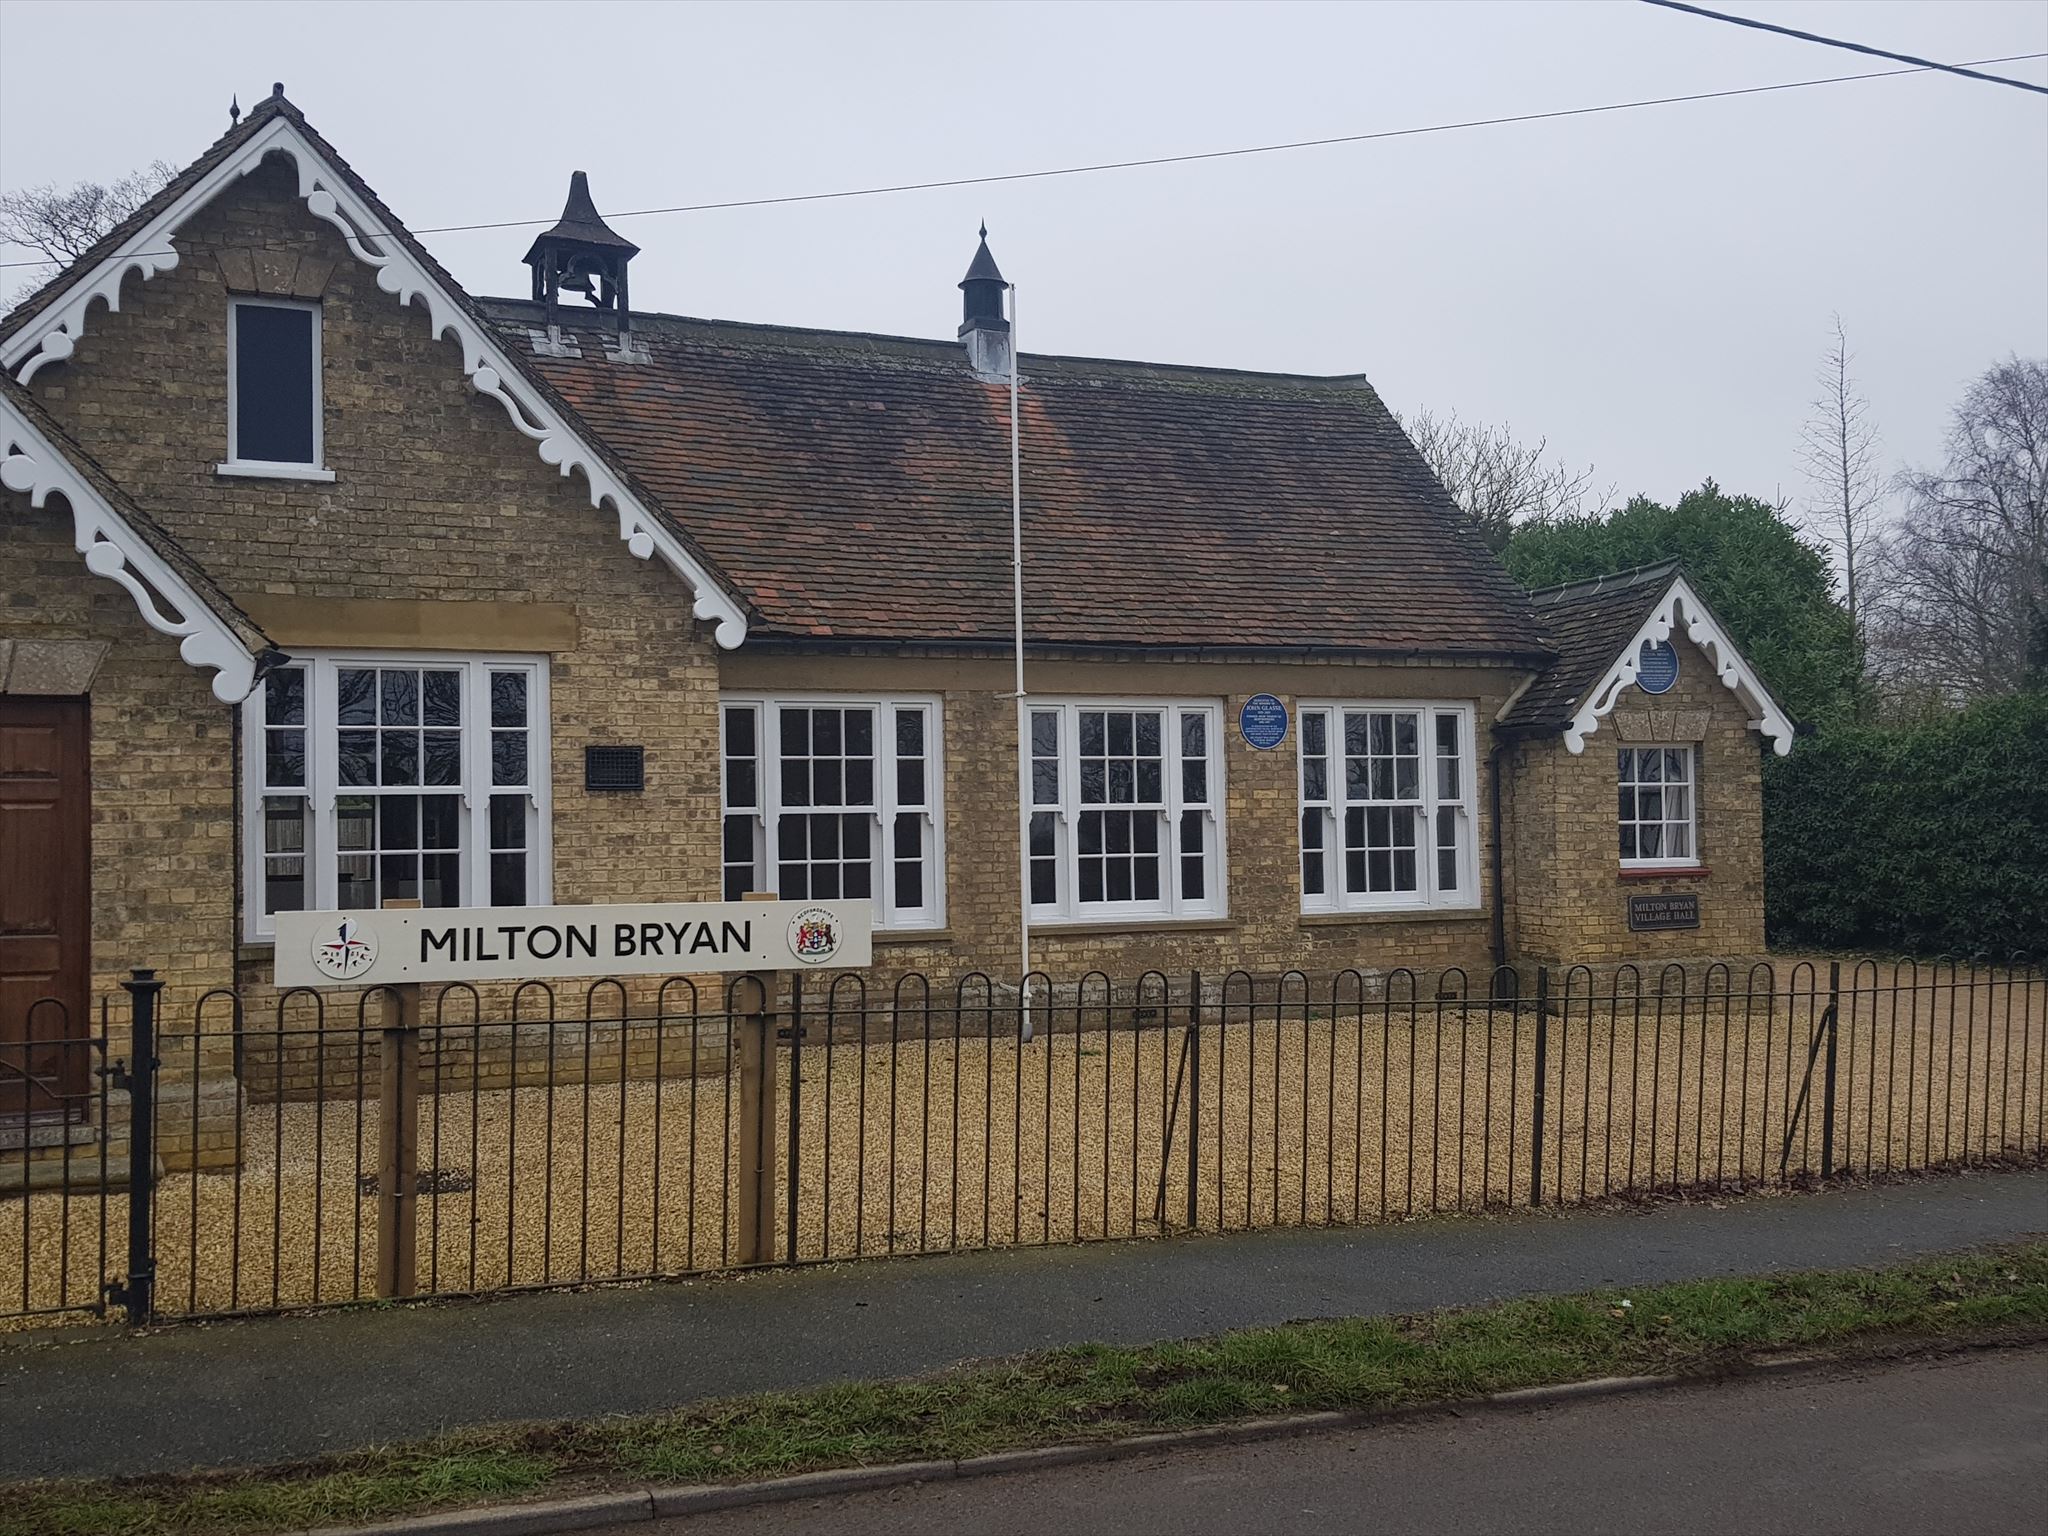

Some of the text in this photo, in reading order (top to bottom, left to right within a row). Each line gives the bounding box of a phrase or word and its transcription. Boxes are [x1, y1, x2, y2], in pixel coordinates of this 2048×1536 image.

[1634, 901, 1695, 912] MILTON BRYAN
[1635, 911, 1696, 922] VILLAGE HALL
[420, 920, 751, 962] MILTON BRYAN
